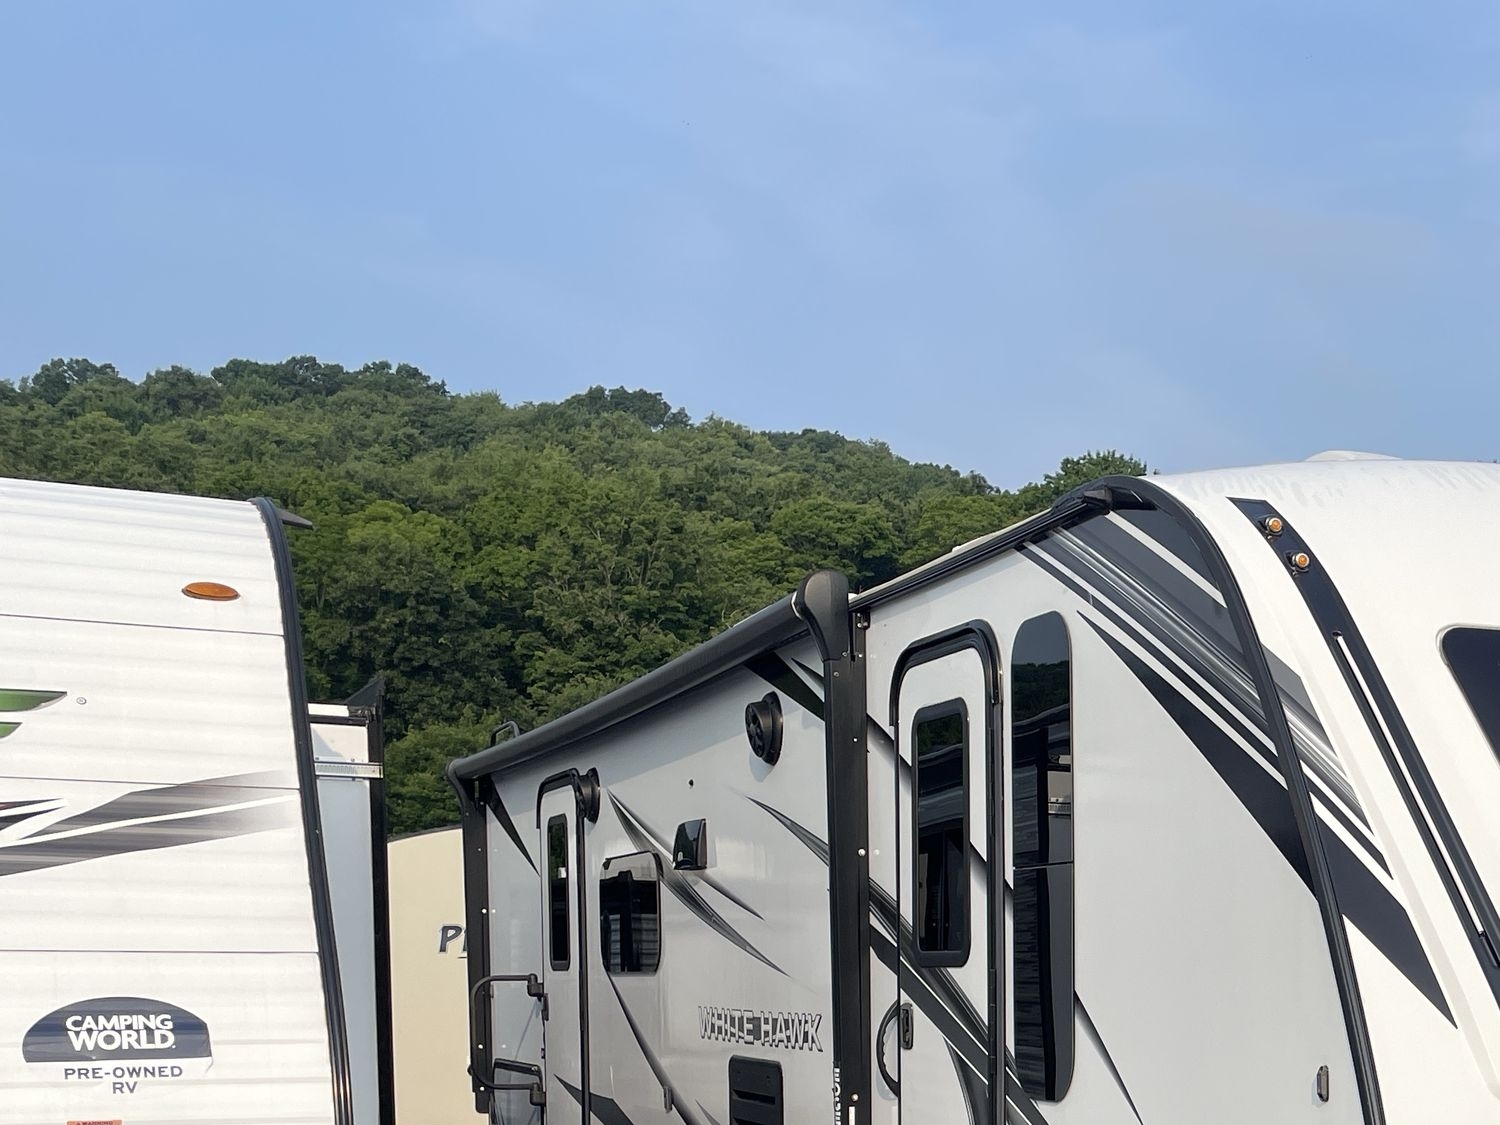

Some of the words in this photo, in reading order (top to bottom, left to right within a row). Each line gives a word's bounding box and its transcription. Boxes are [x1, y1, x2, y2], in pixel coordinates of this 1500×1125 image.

[65, 1014, 174, 1031] CAMPING
[698, 1005, 755, 1045] WHITE
[760, 1010, 824, 1052] HAWK
[63, 1065, 183, 1080] PRE-OWNED
[112, 1081, 138, 1094] RV
